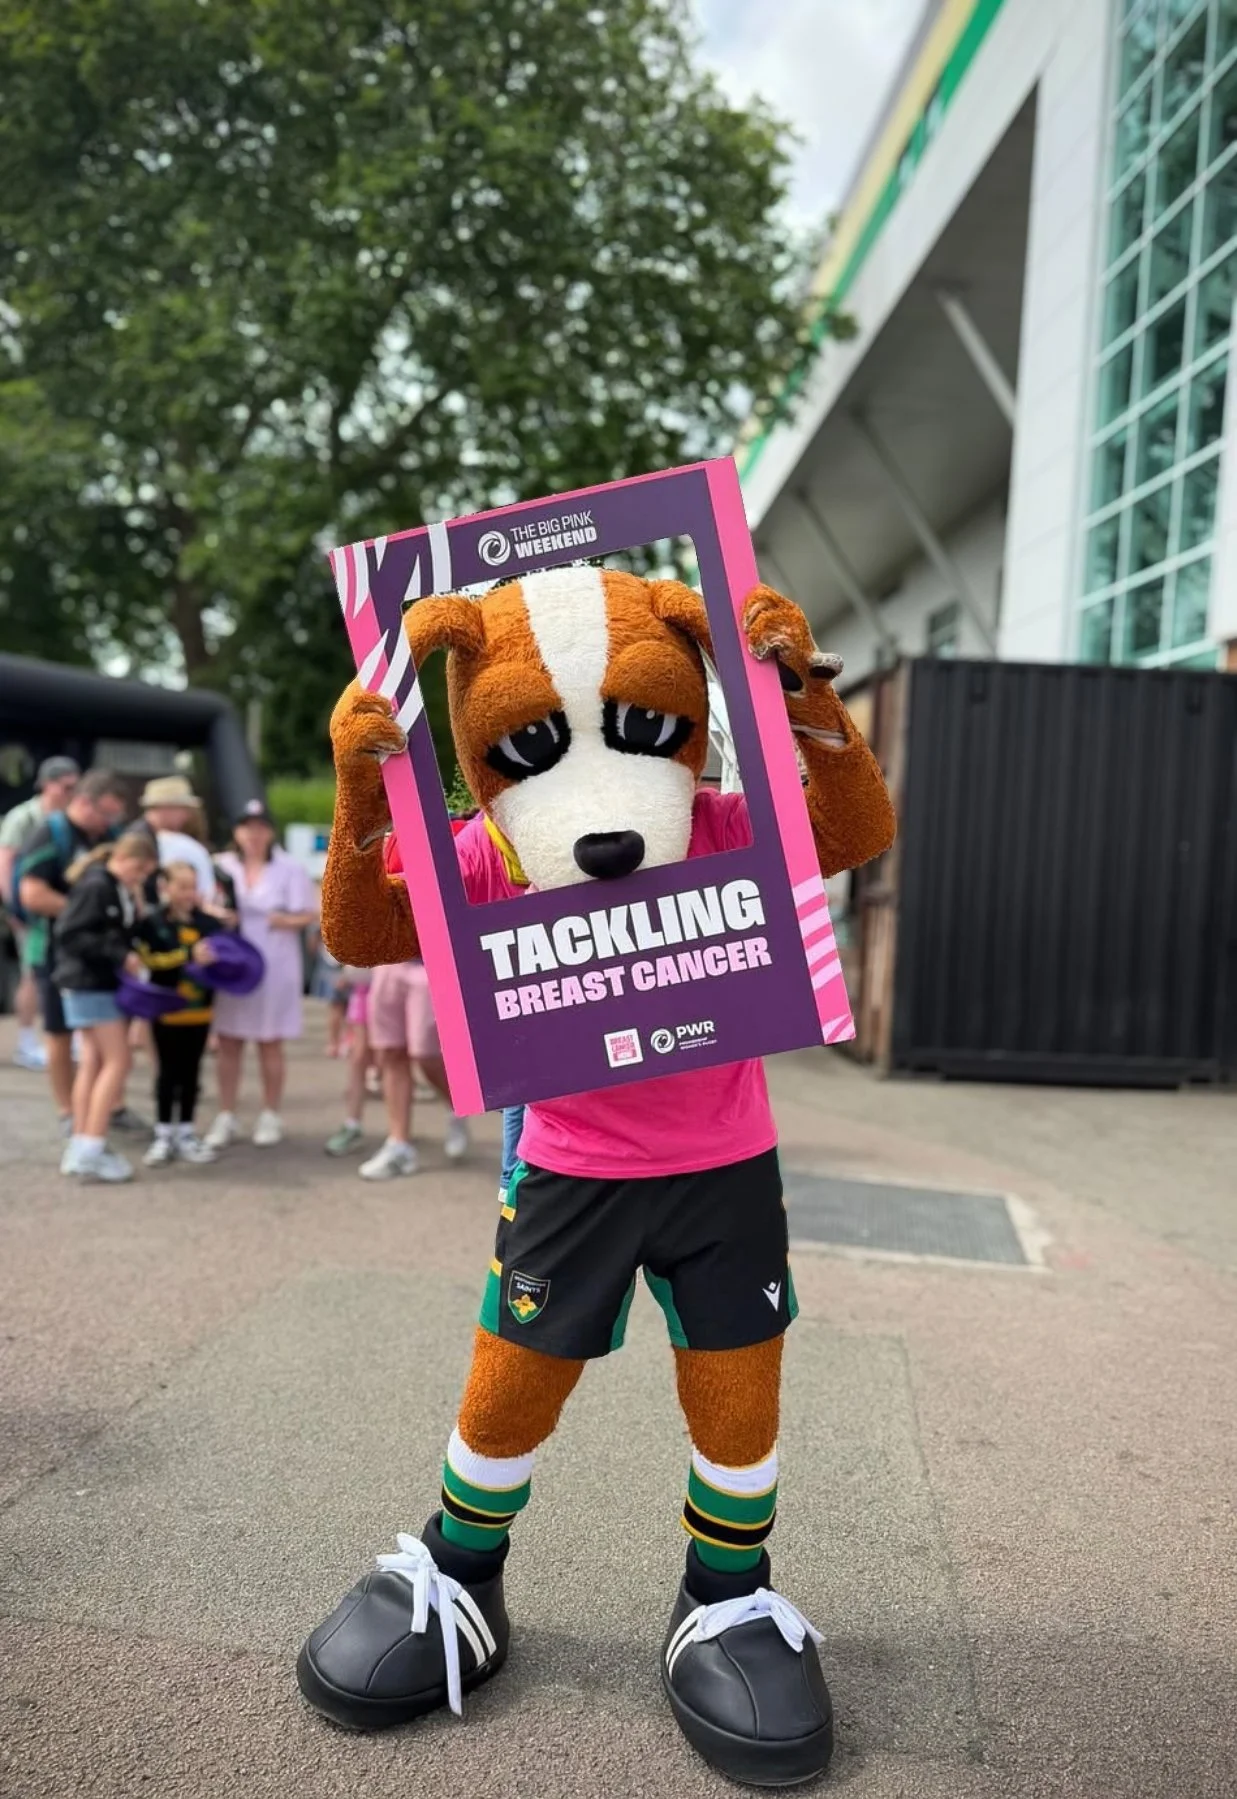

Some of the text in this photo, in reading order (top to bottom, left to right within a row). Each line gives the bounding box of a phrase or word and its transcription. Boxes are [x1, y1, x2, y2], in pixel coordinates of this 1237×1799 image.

[510, 510, 593, 541] THE BIG PINK
[515, 527, 597, 558] WEEKEND
[480, 880, 766, 980] TACKLING
[495, 937, 772, 1020] BREAST CANCER
[676, 1021, 715, 1038] PWR
